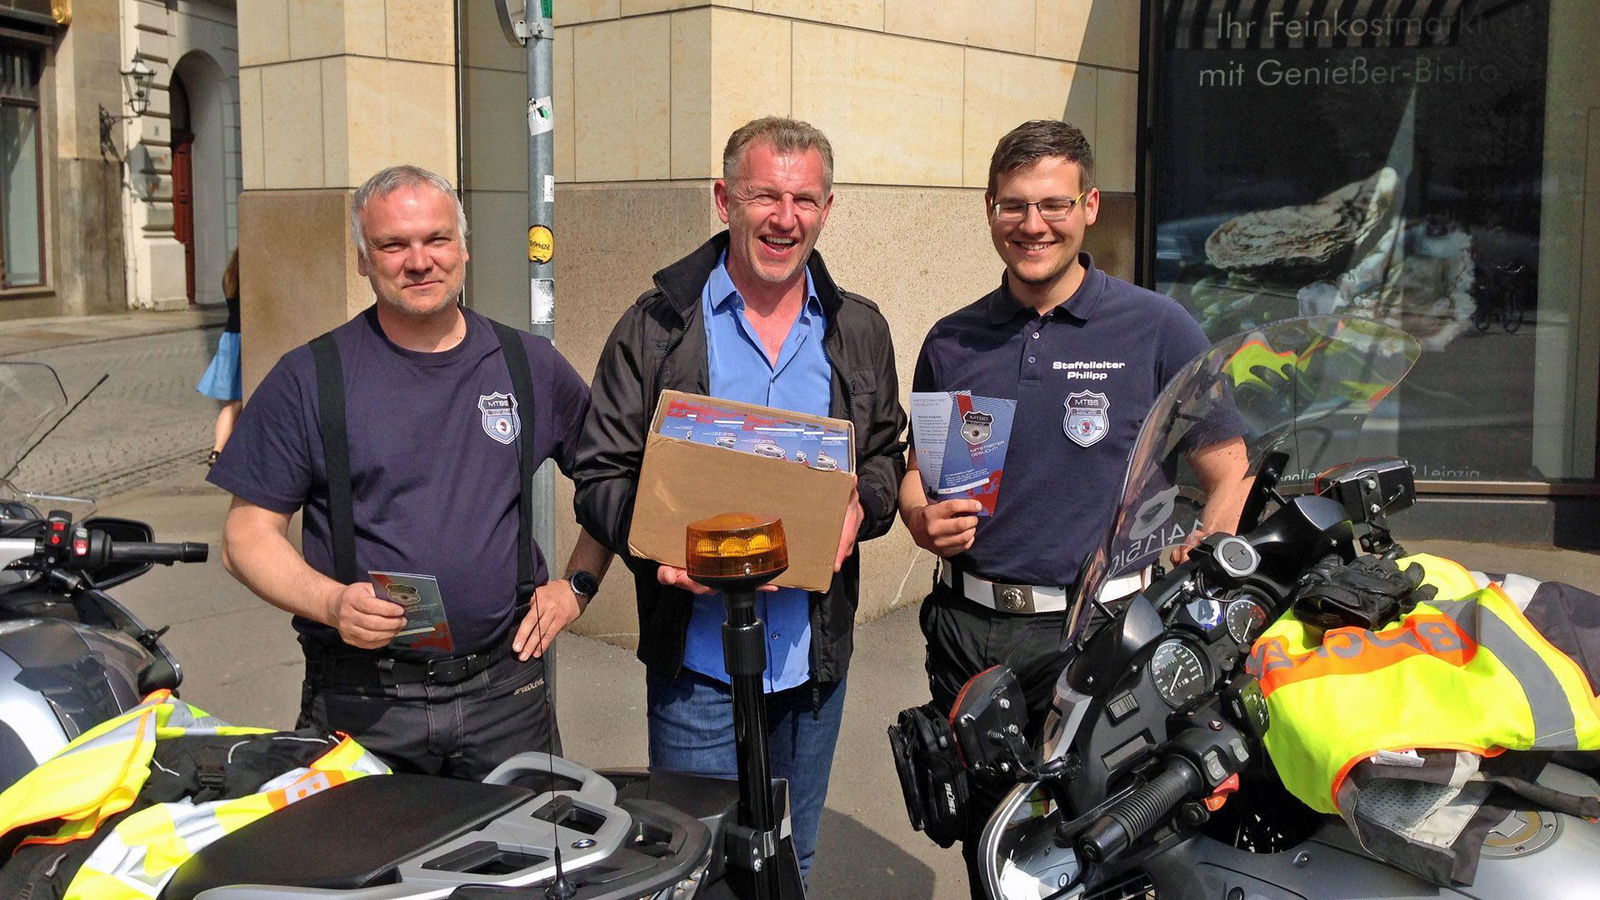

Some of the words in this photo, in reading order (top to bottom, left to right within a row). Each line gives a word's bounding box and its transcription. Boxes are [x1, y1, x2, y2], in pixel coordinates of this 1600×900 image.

[1217, 11, 1257, 39] Ihr
[1199, 60, 1245, 87] mit
[1256, 57, 1499, 87] Genießer-Bistro
[1053, 361, 1126, 370] Staffelleiter
[1067, 371, 1108, 381] Philipp
